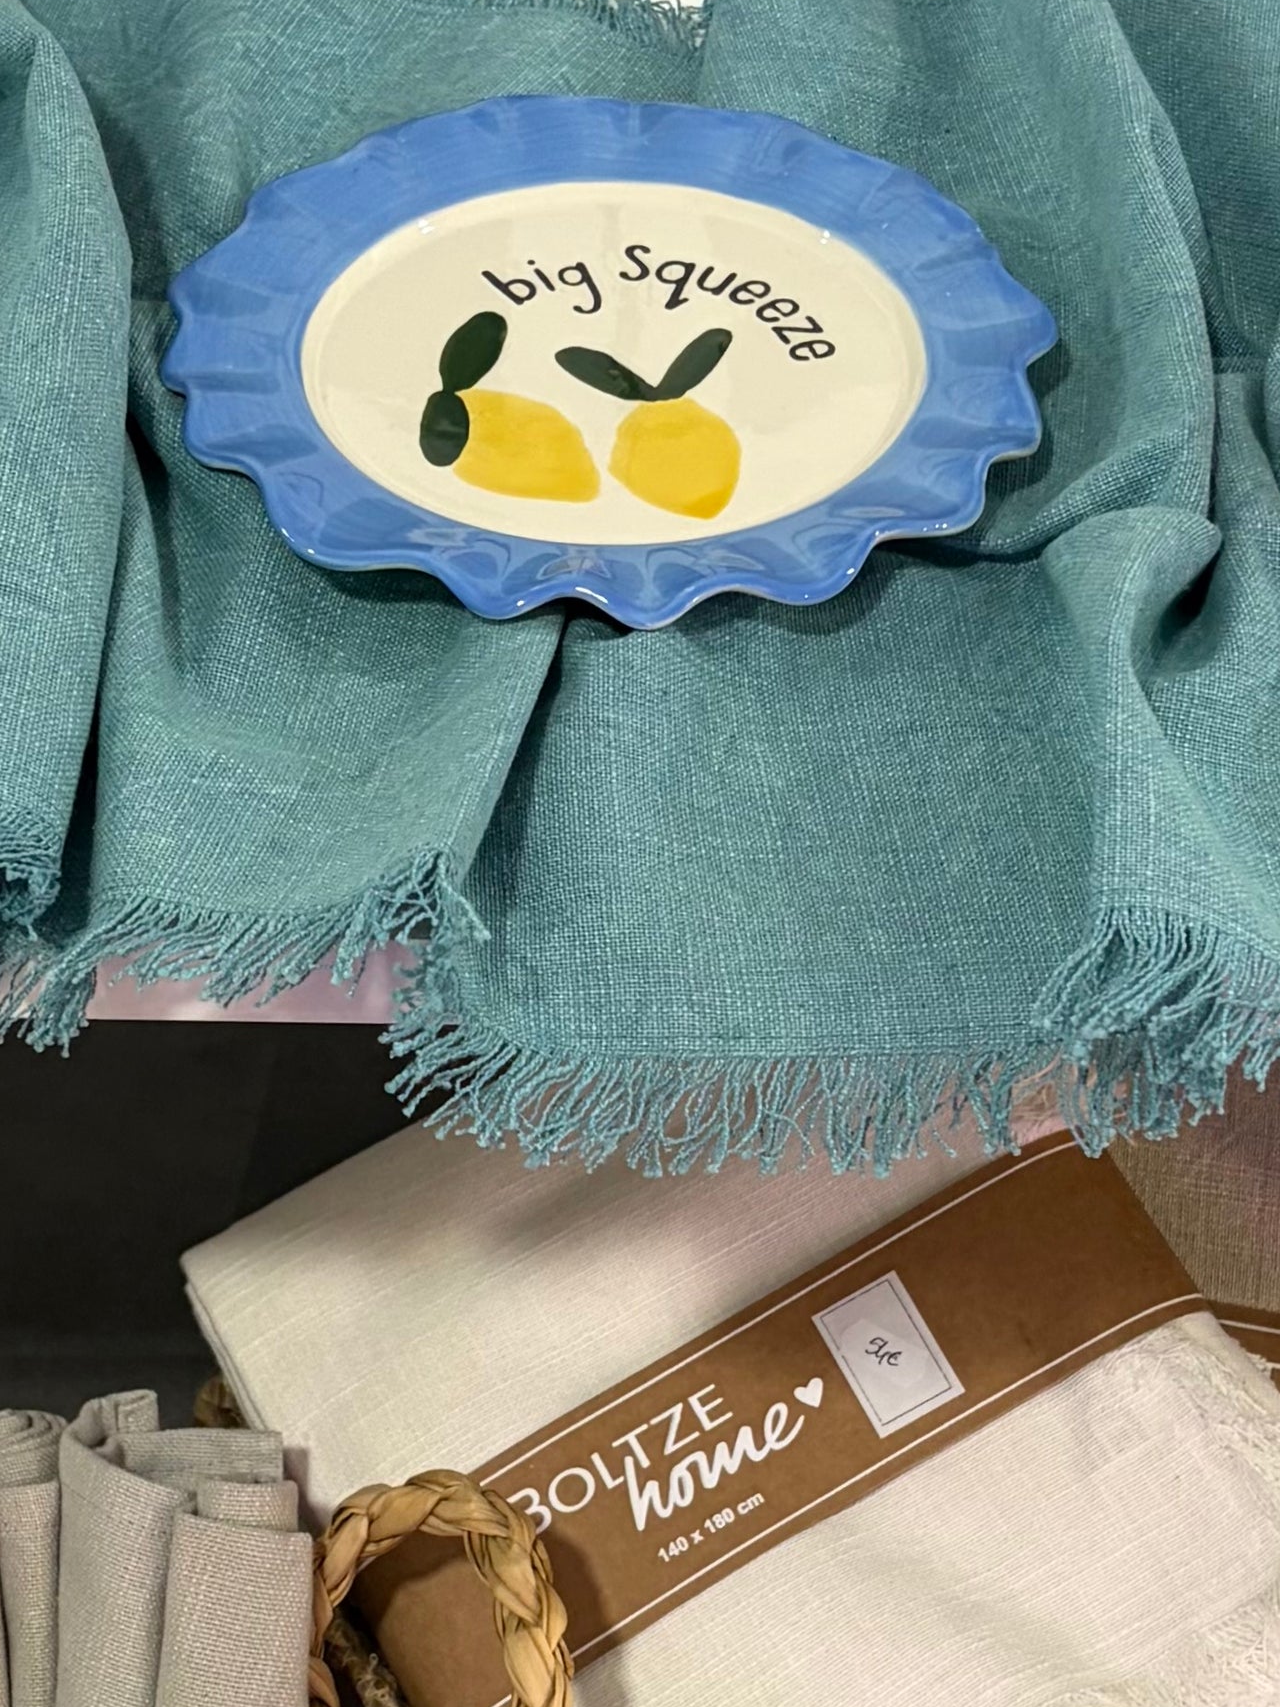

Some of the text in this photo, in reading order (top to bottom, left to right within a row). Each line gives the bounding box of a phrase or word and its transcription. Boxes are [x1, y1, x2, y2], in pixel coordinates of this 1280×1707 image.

[481, 259, 603, 315] big
[623, 1401, 805, 1532] home
[657, 1492, 765, 1563] 140 x 180 cm
